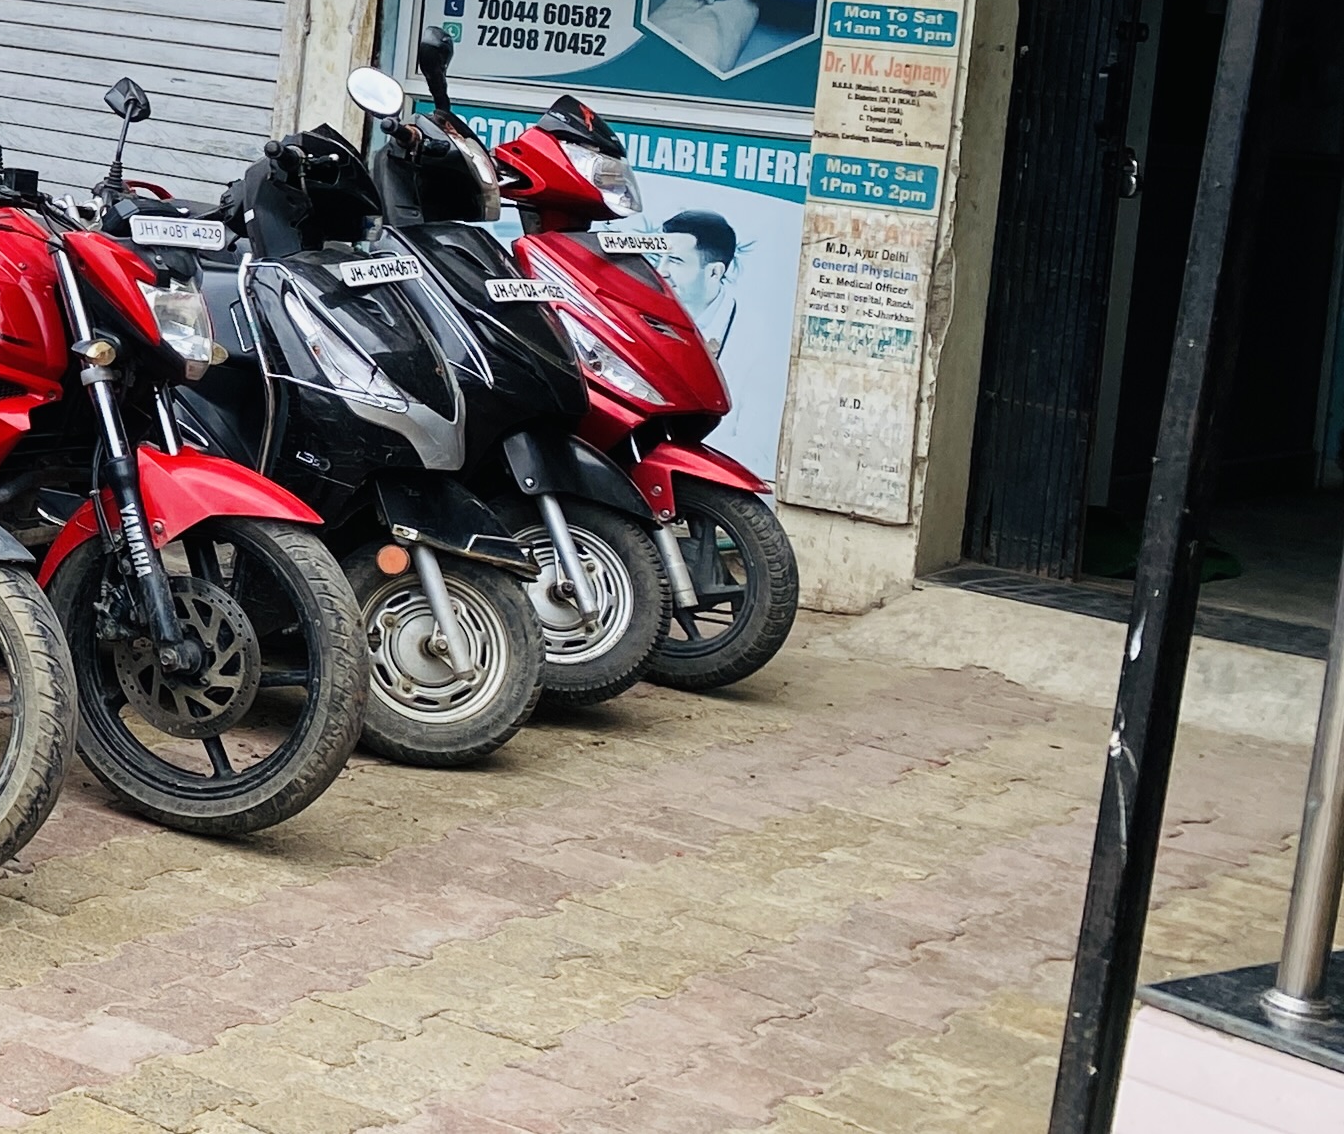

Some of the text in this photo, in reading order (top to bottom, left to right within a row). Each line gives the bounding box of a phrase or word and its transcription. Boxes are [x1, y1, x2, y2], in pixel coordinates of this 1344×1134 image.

[544, 3, 613, 30] 60582
[844, 4, 945, 26] Mon To Sat
[476, 24, 607, 57] 72098 70452
[832, 20, 953, 43] 11am To 1pm
[825, 157, 925, 183] Mon To Sat
[861, 181, 928, 204] To 2pm
[811, 256, 858, 274] General
[120, 501, 153, 579] YAMAHA
